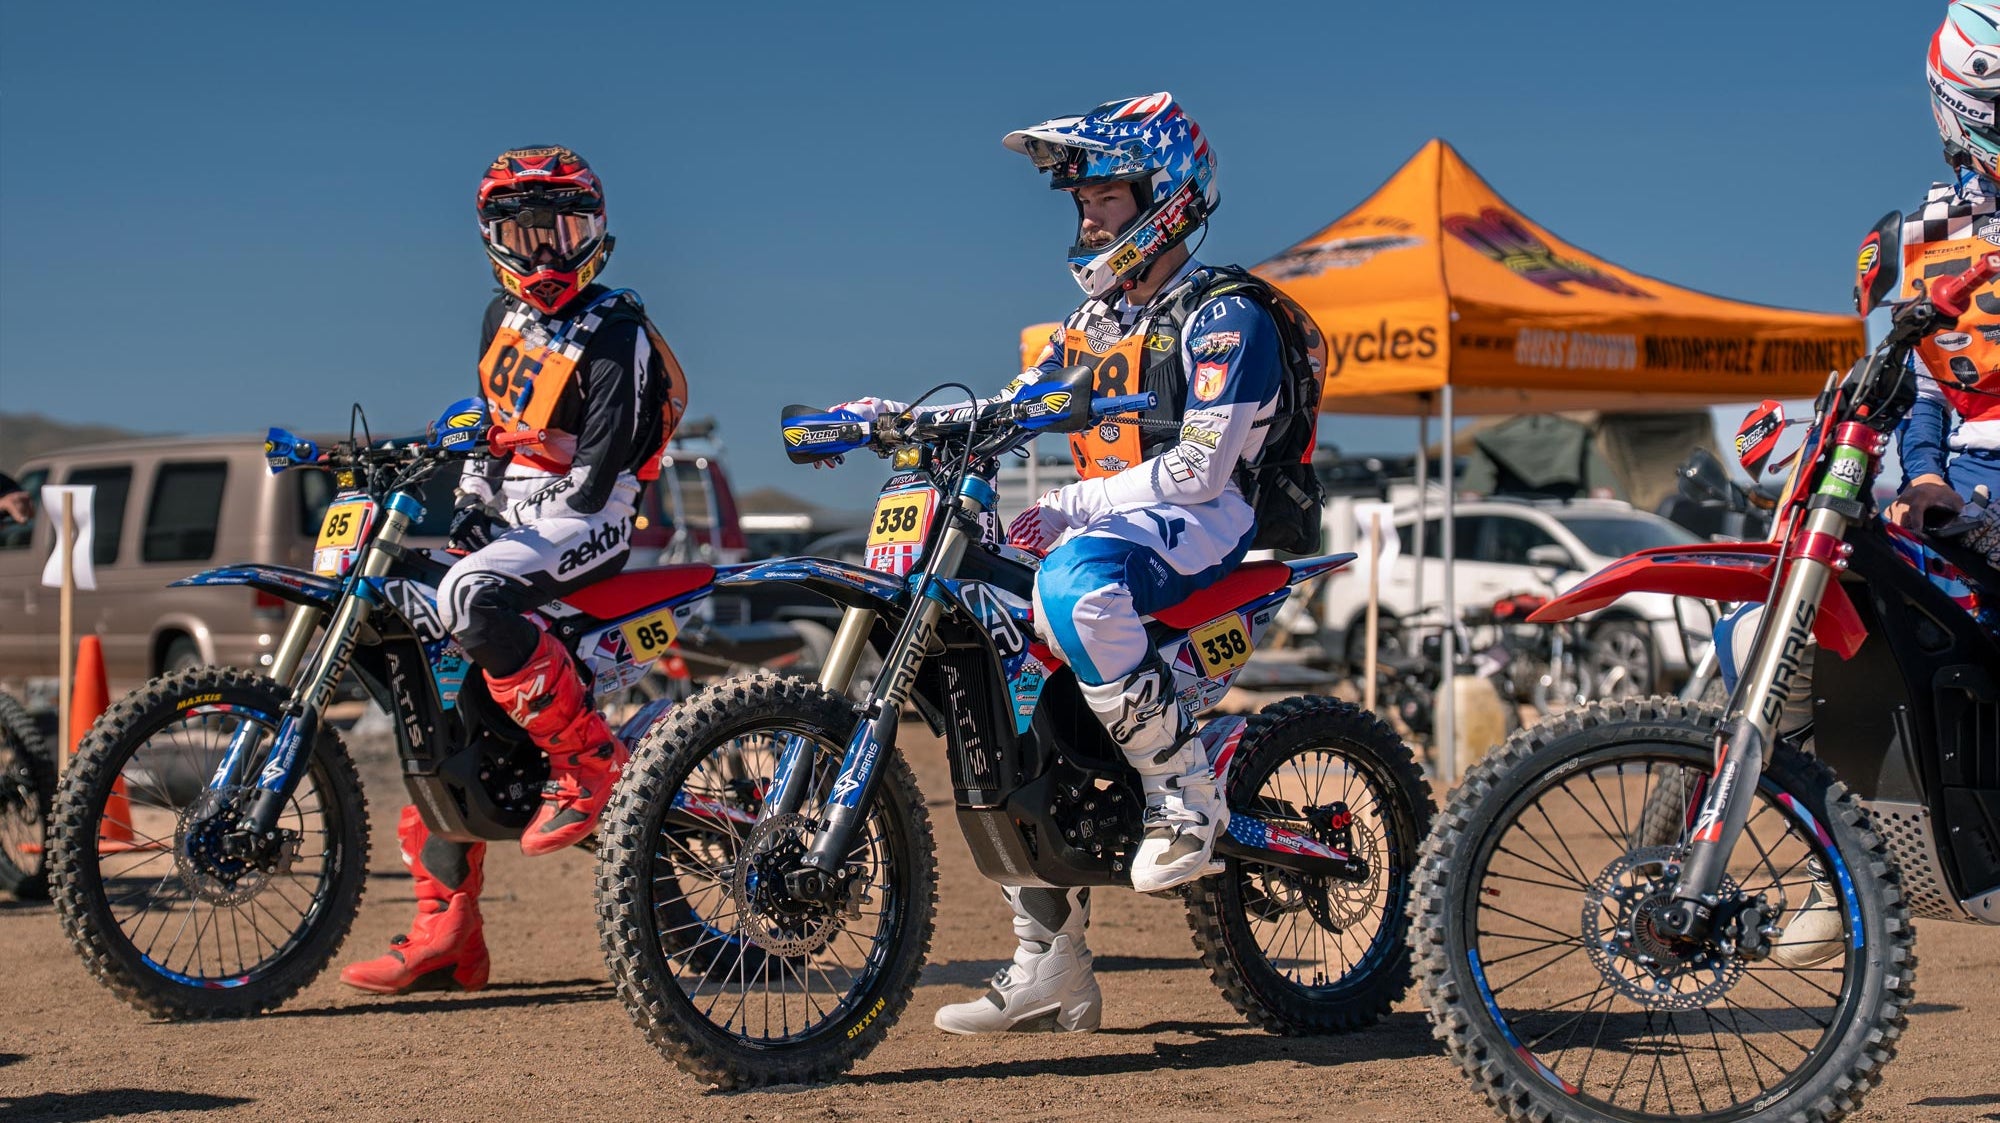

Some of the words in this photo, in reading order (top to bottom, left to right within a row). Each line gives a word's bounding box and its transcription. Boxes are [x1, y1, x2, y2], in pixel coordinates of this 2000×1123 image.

[1113, 250, 1137, 270] 338
[1644, 335, 1754, 374] MOTORCYCLE
[1760, 336, 1861, 375] ATTORNEYS
[489, 345, 544, 412] 85
[1027, 403, 1048, 414] CYCRA
[442, 432, 469, 447] CYCRA
[801, 429, 839, 441] CYCRA
[1100, 425, 1119, 437] 805
[890, 474, 918, 486] RITSON
[326, 512, 352, 538] 85
[876, 505, 918, 535] 338
[636, 620, 669, 650] 85
[1202, 628, 1247, 666] 338
[316, 617, 362, 707] SIRRIS
[1762, 599, 1816, 729] SIRRIS
[177, 693, 222, 711] MAXXIS
[385, 652, 424, 748] ALTIS
[940, 665, 990, 776] ALTIS
[1632, 728, 1714, 742] MAXX
[857, 742, 878, 781] SIRRIS
[847, 997, 886, 1039] MAXXIS
